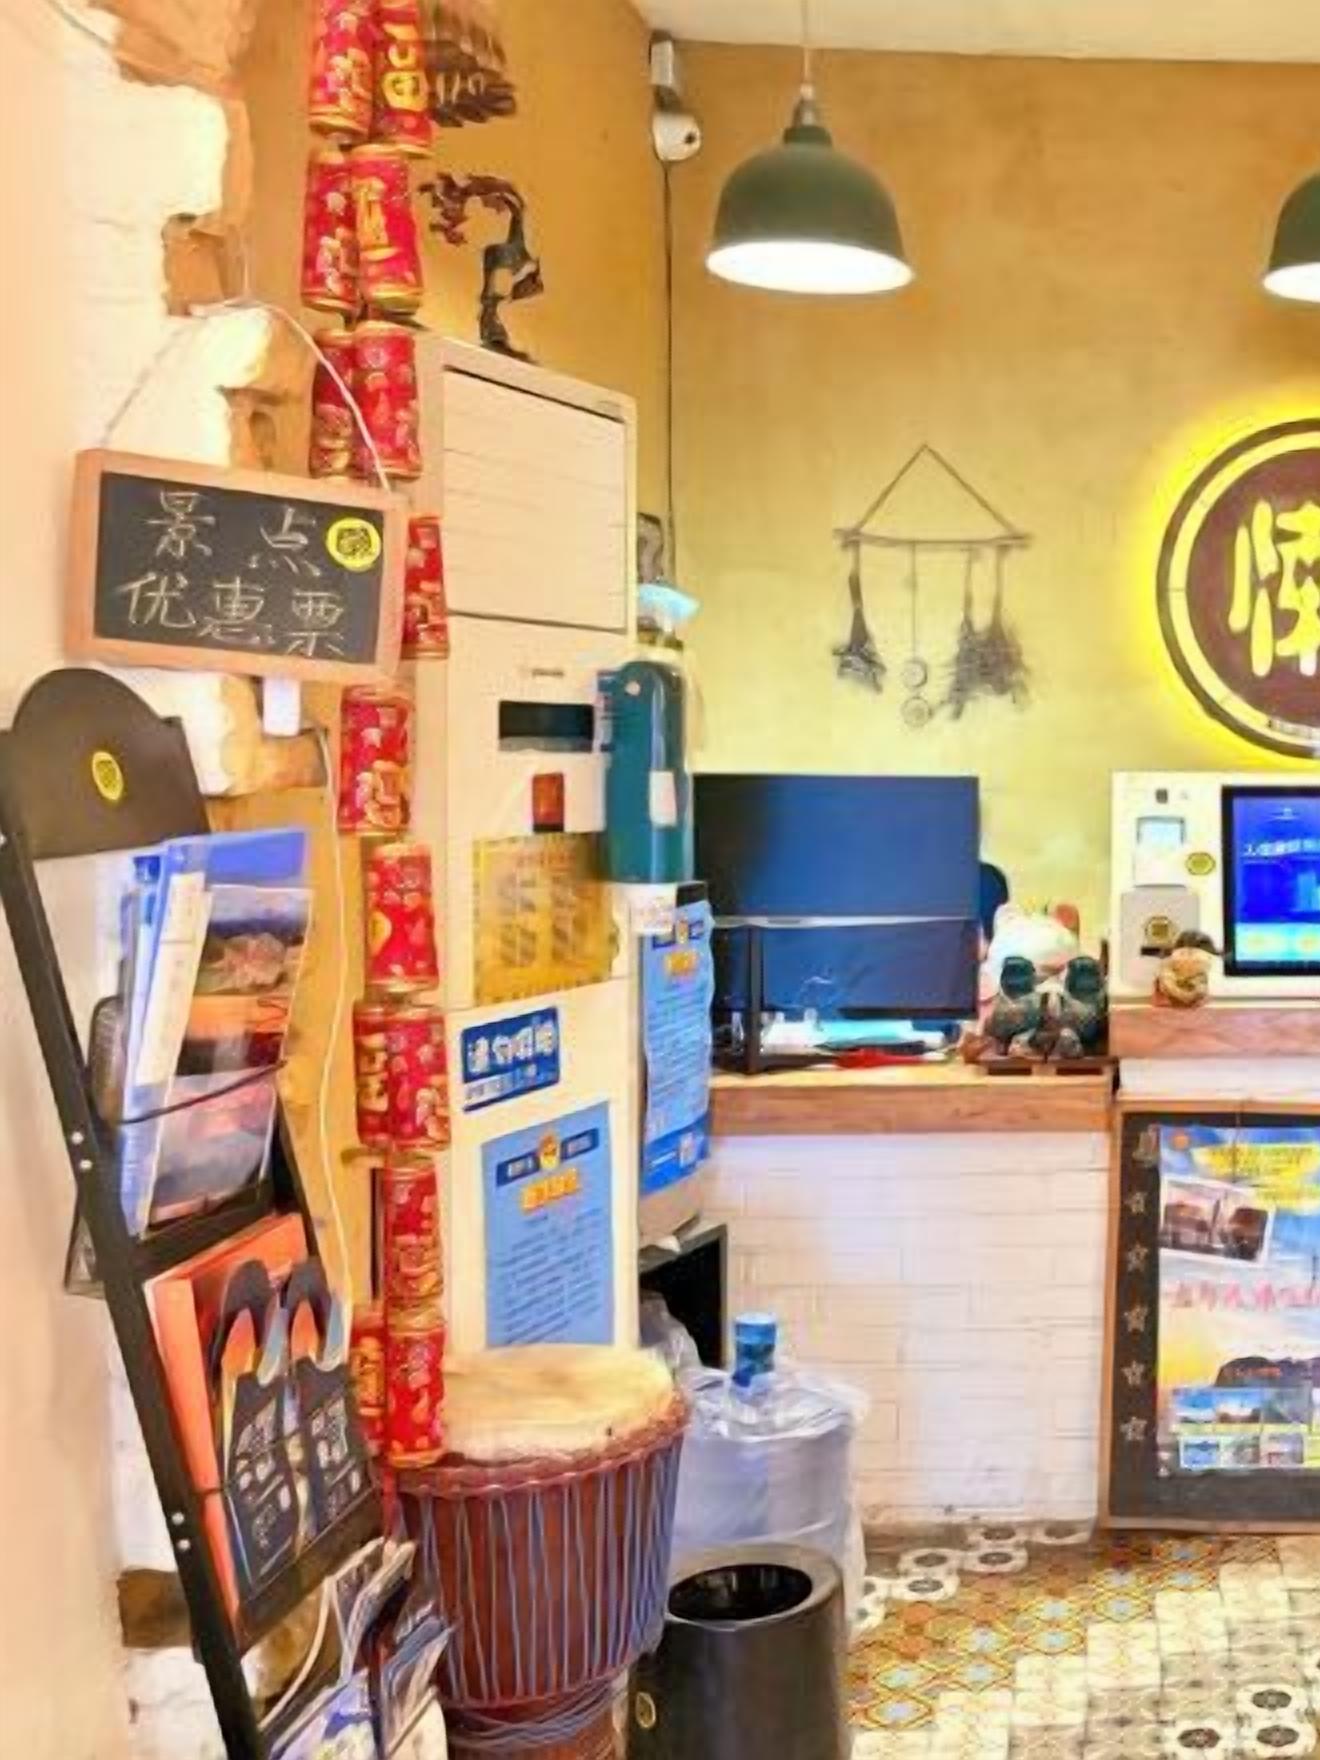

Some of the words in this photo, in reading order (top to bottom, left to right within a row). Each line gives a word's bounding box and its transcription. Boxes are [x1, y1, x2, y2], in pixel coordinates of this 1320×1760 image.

[146, 490, 323, 576] 景点
[118, 569, 347, 657] 优惠票
